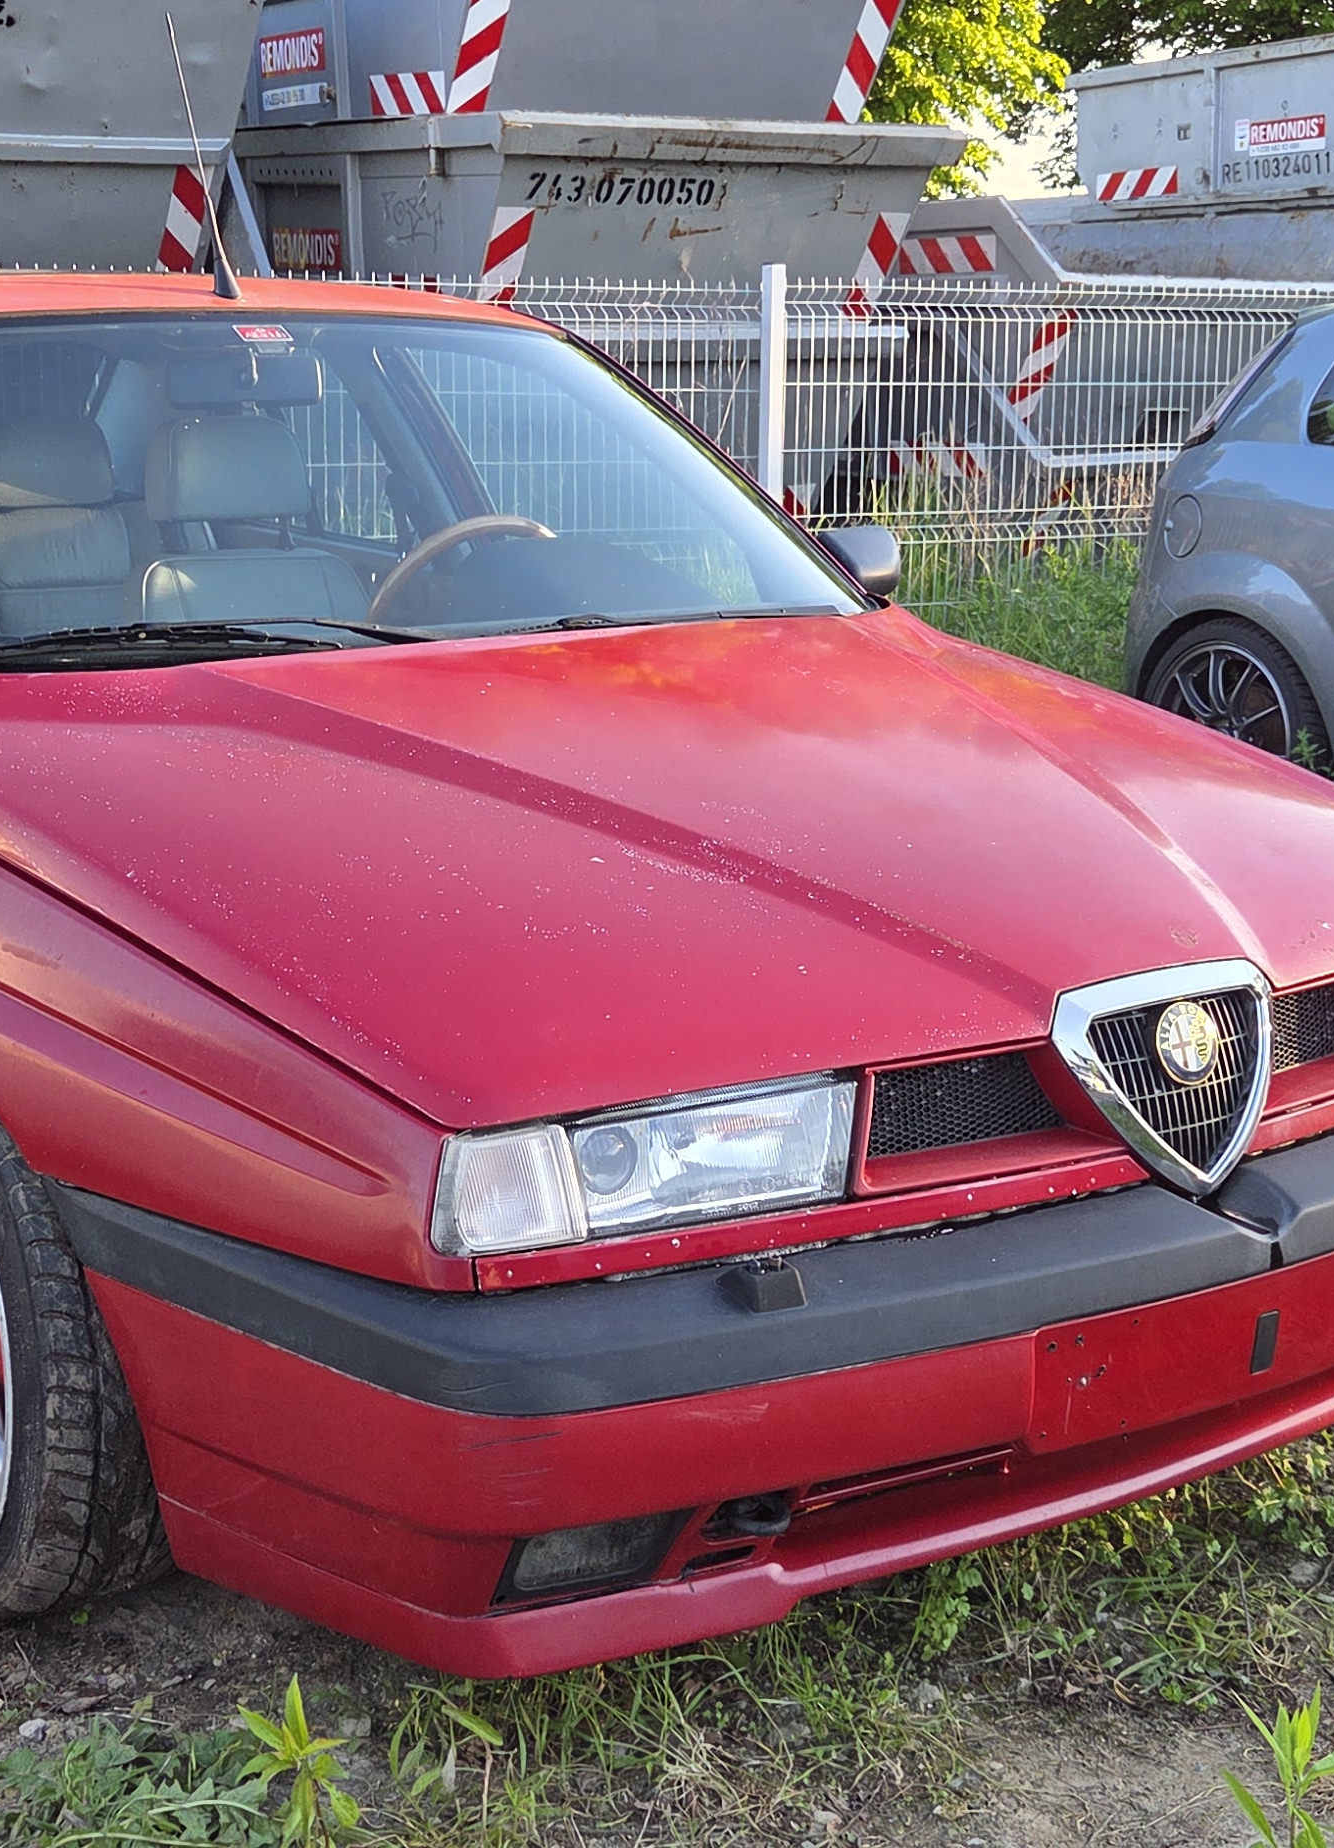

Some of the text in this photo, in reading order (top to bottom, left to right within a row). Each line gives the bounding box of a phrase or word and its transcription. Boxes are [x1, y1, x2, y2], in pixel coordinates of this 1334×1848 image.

[260, 33, 320, 74] REMONDIS
[1250, 117, 1320, 144] REMONDIS
[272, 232, 336, 268] REMONDIS
